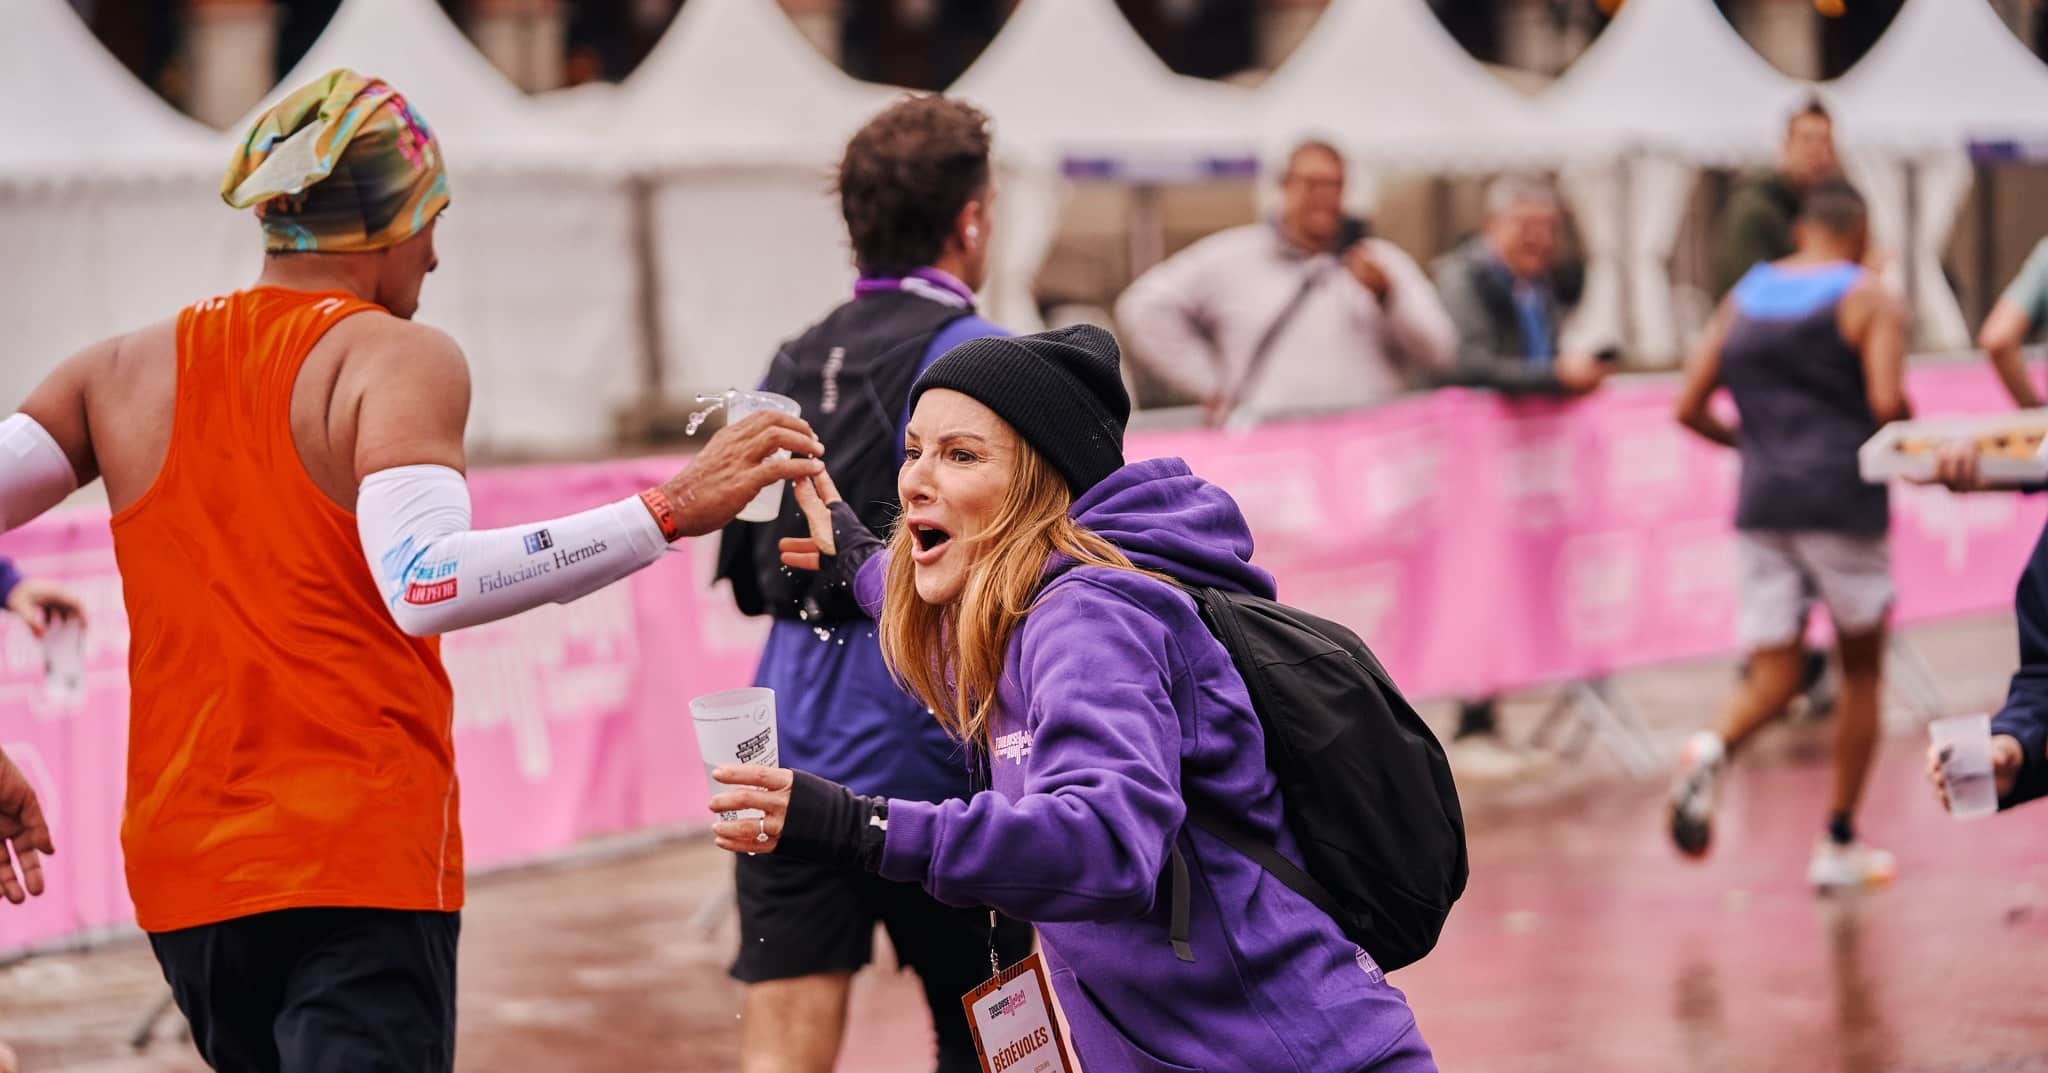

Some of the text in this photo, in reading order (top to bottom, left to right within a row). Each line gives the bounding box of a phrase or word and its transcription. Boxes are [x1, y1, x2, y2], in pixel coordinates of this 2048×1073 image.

[479, 539, 608, 594] Fiduciaire Hermès
[992, 1026, 1049, 1073] BÉNÉVOLES
